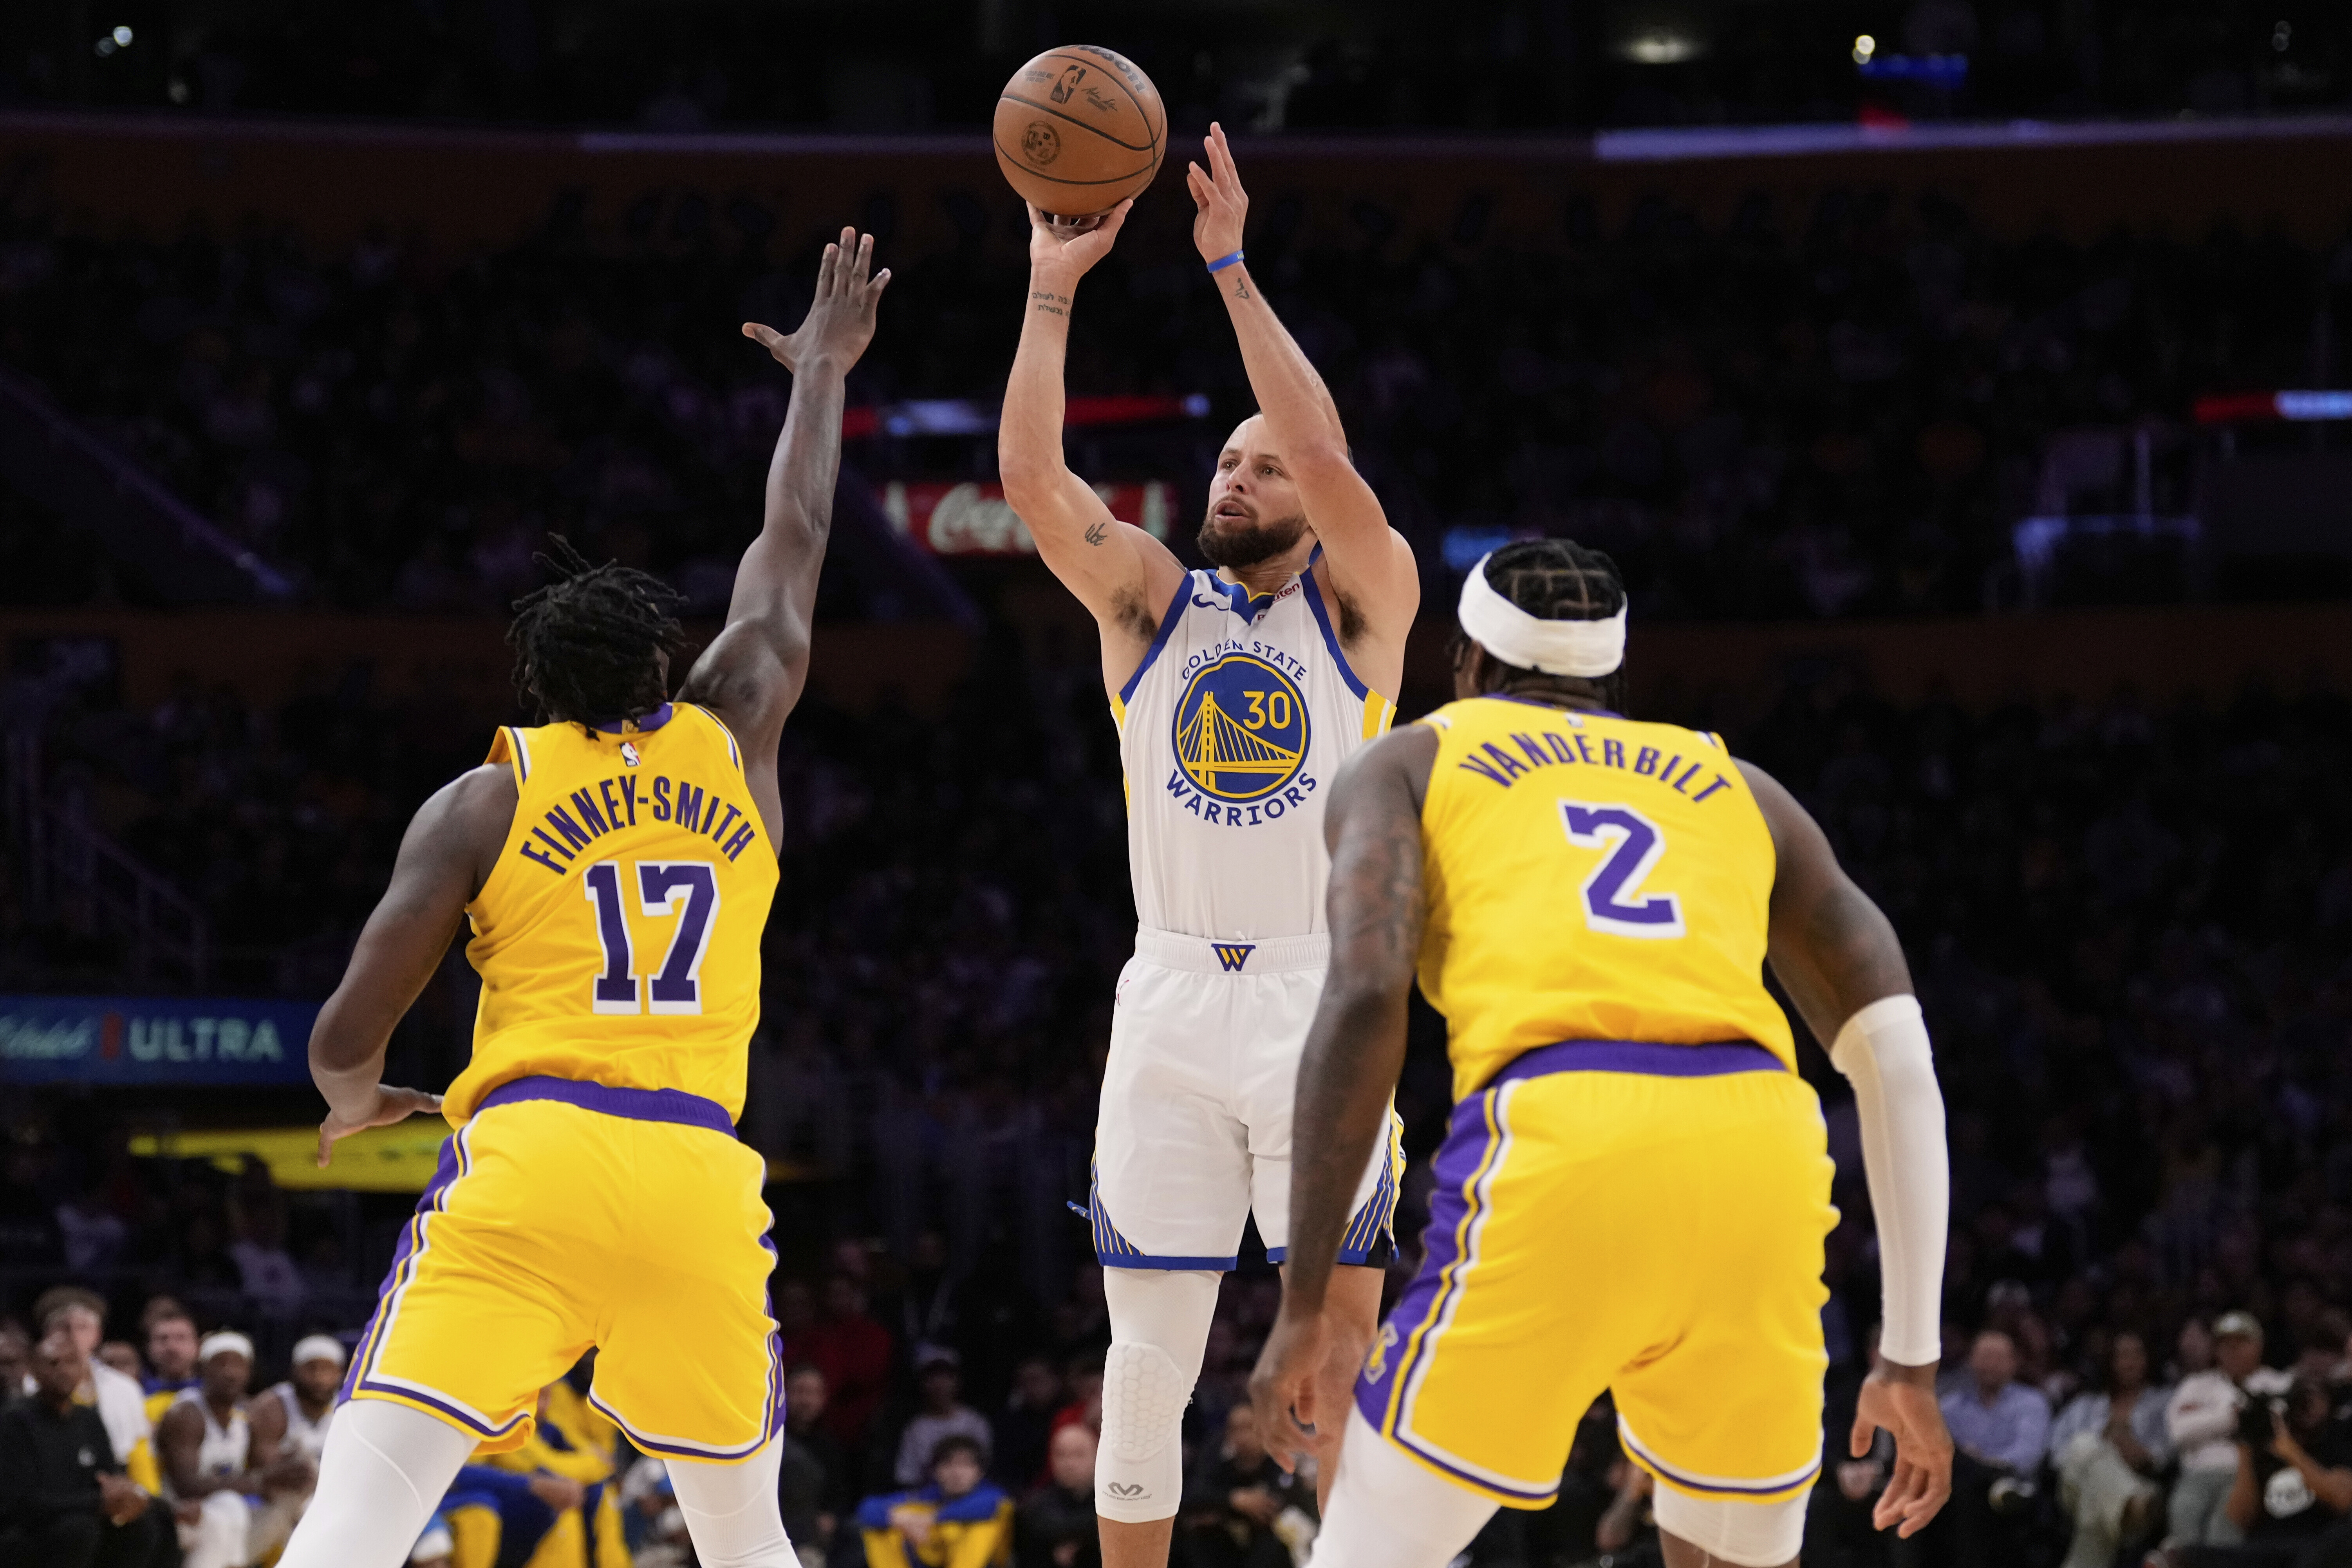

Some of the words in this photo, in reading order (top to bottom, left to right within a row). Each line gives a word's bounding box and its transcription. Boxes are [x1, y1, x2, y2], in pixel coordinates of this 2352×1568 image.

[1182, 639, 1244, 680] GOLDEN
[1253, 641, 1306, 681] STATE
[1243, 691, 1291, 730] 30
[1166, 769, 1317, 827] WARRIORS
[1459, 732, 1732, 803] VANDERBILT
[519, 774, 756, 876] FINNEY-SMITH
[1557, 797, 1687, 938] 2
[583, 860, 721, 1015] 17
[128, 1017, 284, 1063] ULTRA
